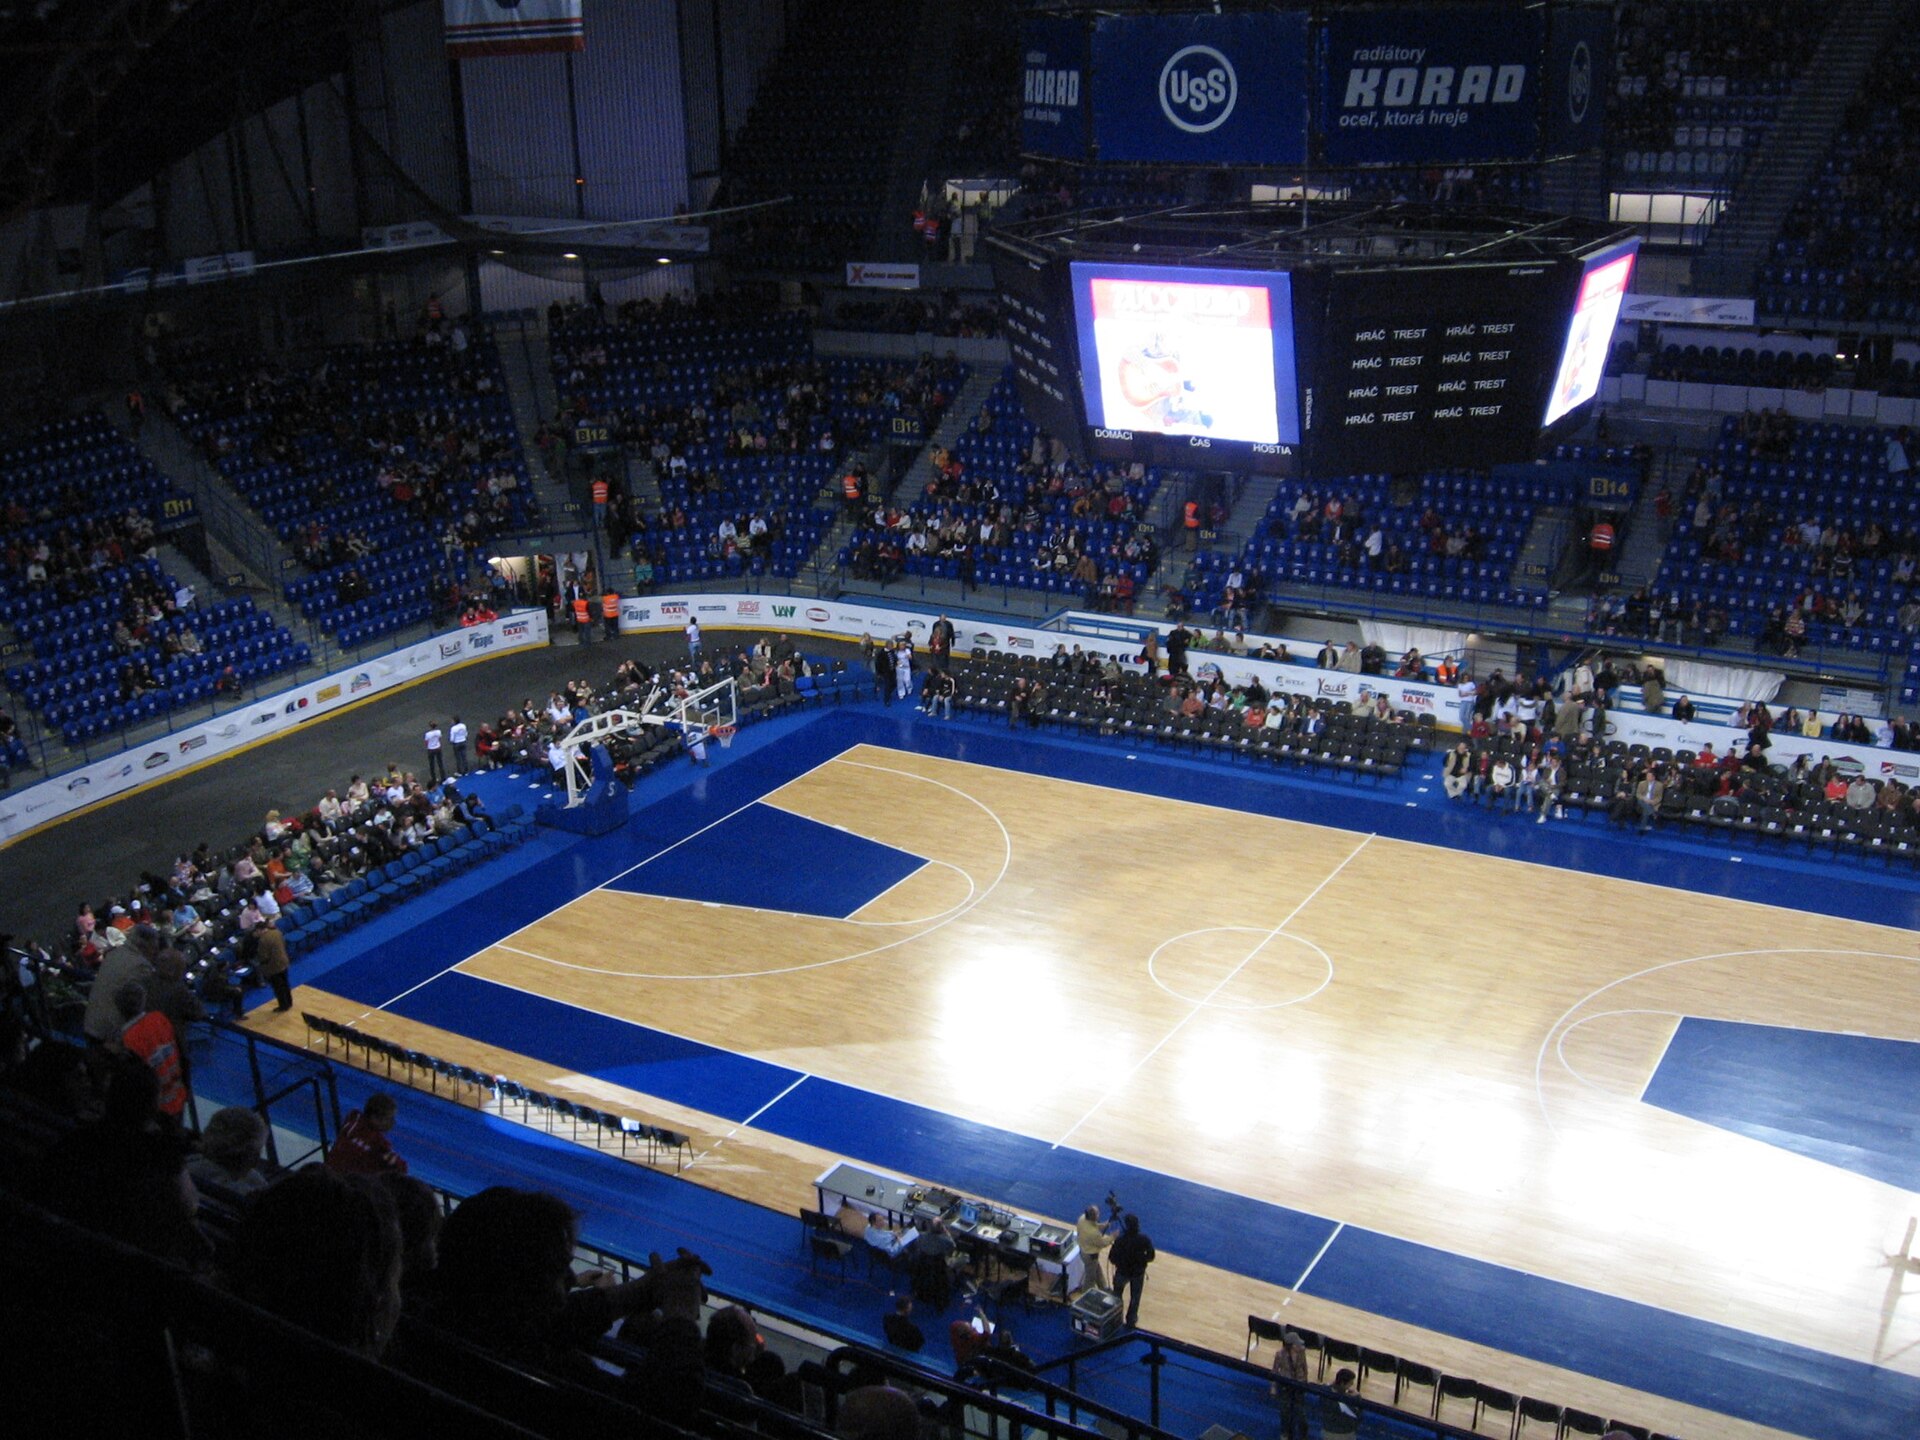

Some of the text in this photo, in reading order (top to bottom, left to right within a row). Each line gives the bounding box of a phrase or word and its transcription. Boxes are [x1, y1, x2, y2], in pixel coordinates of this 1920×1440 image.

[1353, 45, 1426, 64] radiátory
[1024, 69, 1080, 106] KORAD
[1343, 64, 1527, 107] KORAD
[1384, 109, 1425, 125] ktorá
[1428, 109, 1469, 127] hreje
[1356, 328, 1428, 342] HRÁČ TREST
[1446, 323, 1516, 336] HRÁČ TREST
[1352, 355, 1424, 370] HRÁČ TREST
[1442, 350, 1511, 364] HRÁČ TREST
[1348, 384, 1420, 398] HRÁČ TREST
[1438, 378, 1506, 392] HRÁČ TREST
[1344, 410, 1416, 426] HRÁČ TREST
[1434, 405, 1502, 419] HRÁČ TREST
[1189, 436, 1212, 448] ČAS
[1252, 444, 1292, 456] HOSTIA
[1402, 694, 1425, 705] TAXI
